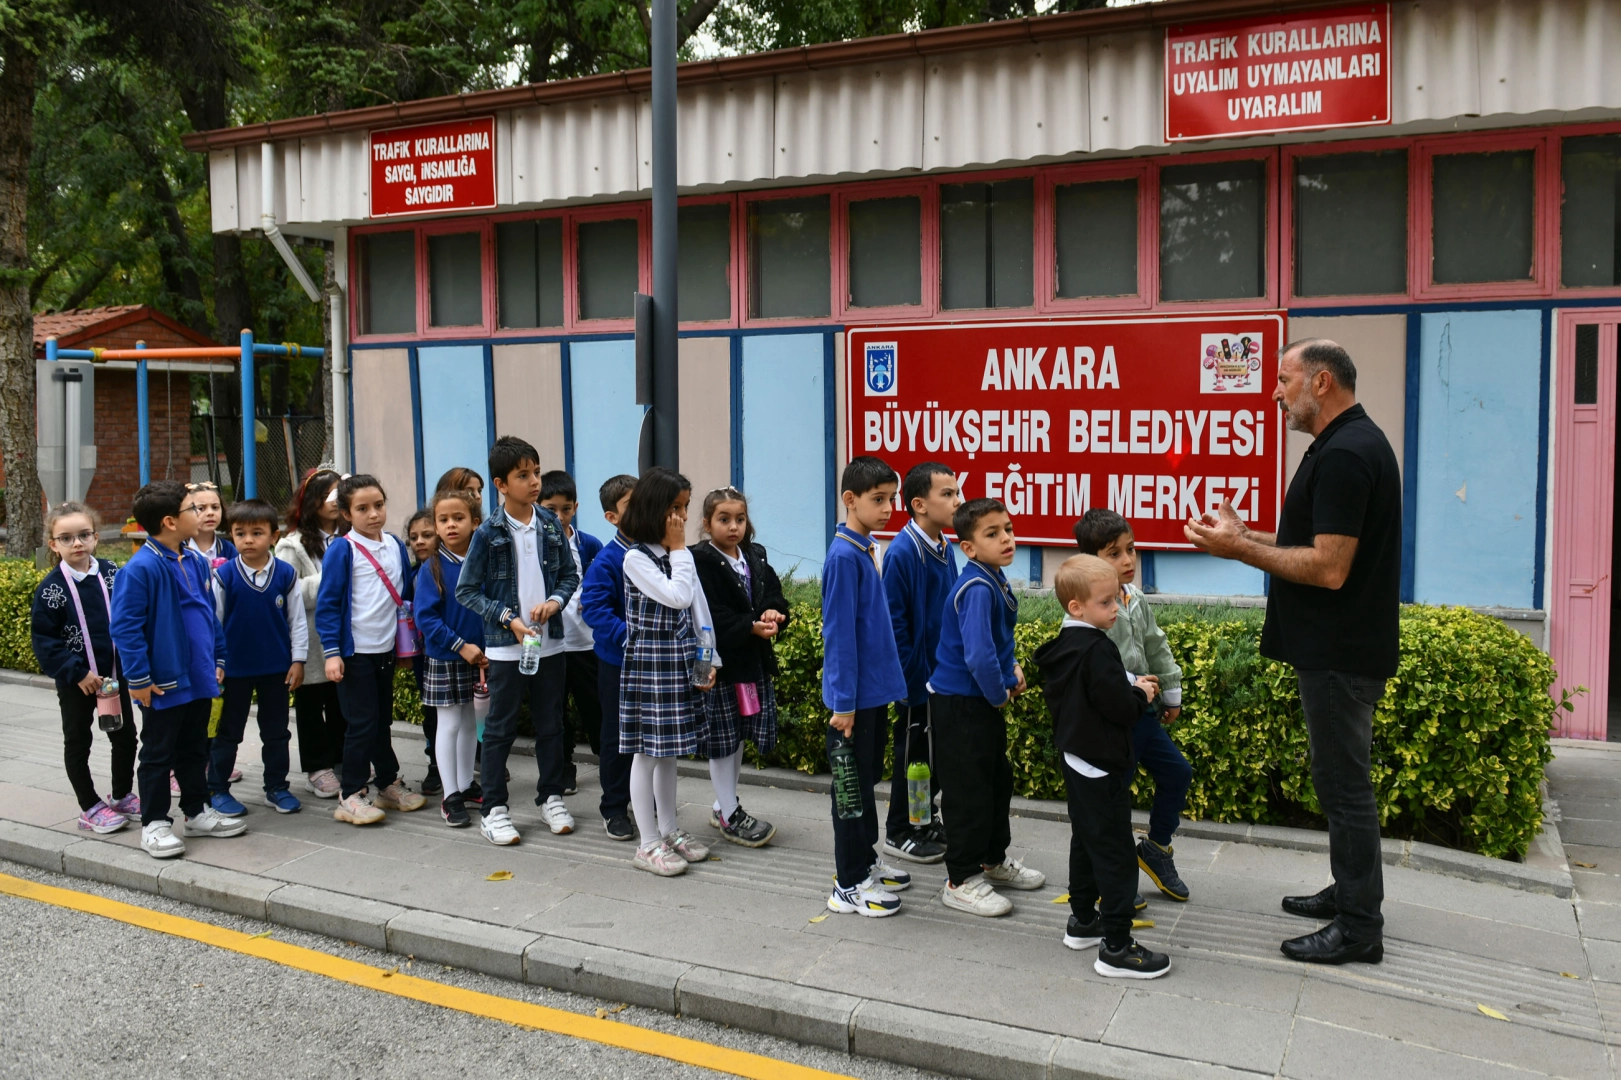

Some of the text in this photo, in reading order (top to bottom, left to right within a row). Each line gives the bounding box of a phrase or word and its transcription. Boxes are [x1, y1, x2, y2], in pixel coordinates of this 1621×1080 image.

[1247, 20, 1382, 57] KURALLARINA
[1173, 52, 1381, 96] UYALIM UYMAYANLARI
[1227, 90, 1322, 121] UYARALIM
[415, 131, 490, 157] KURALLARINA
[385, 163, 417, 185] SAYGI,
[405, 184, 454, 205] SAYGIDIR
[981, 345, 1120, 391] ANKARA
